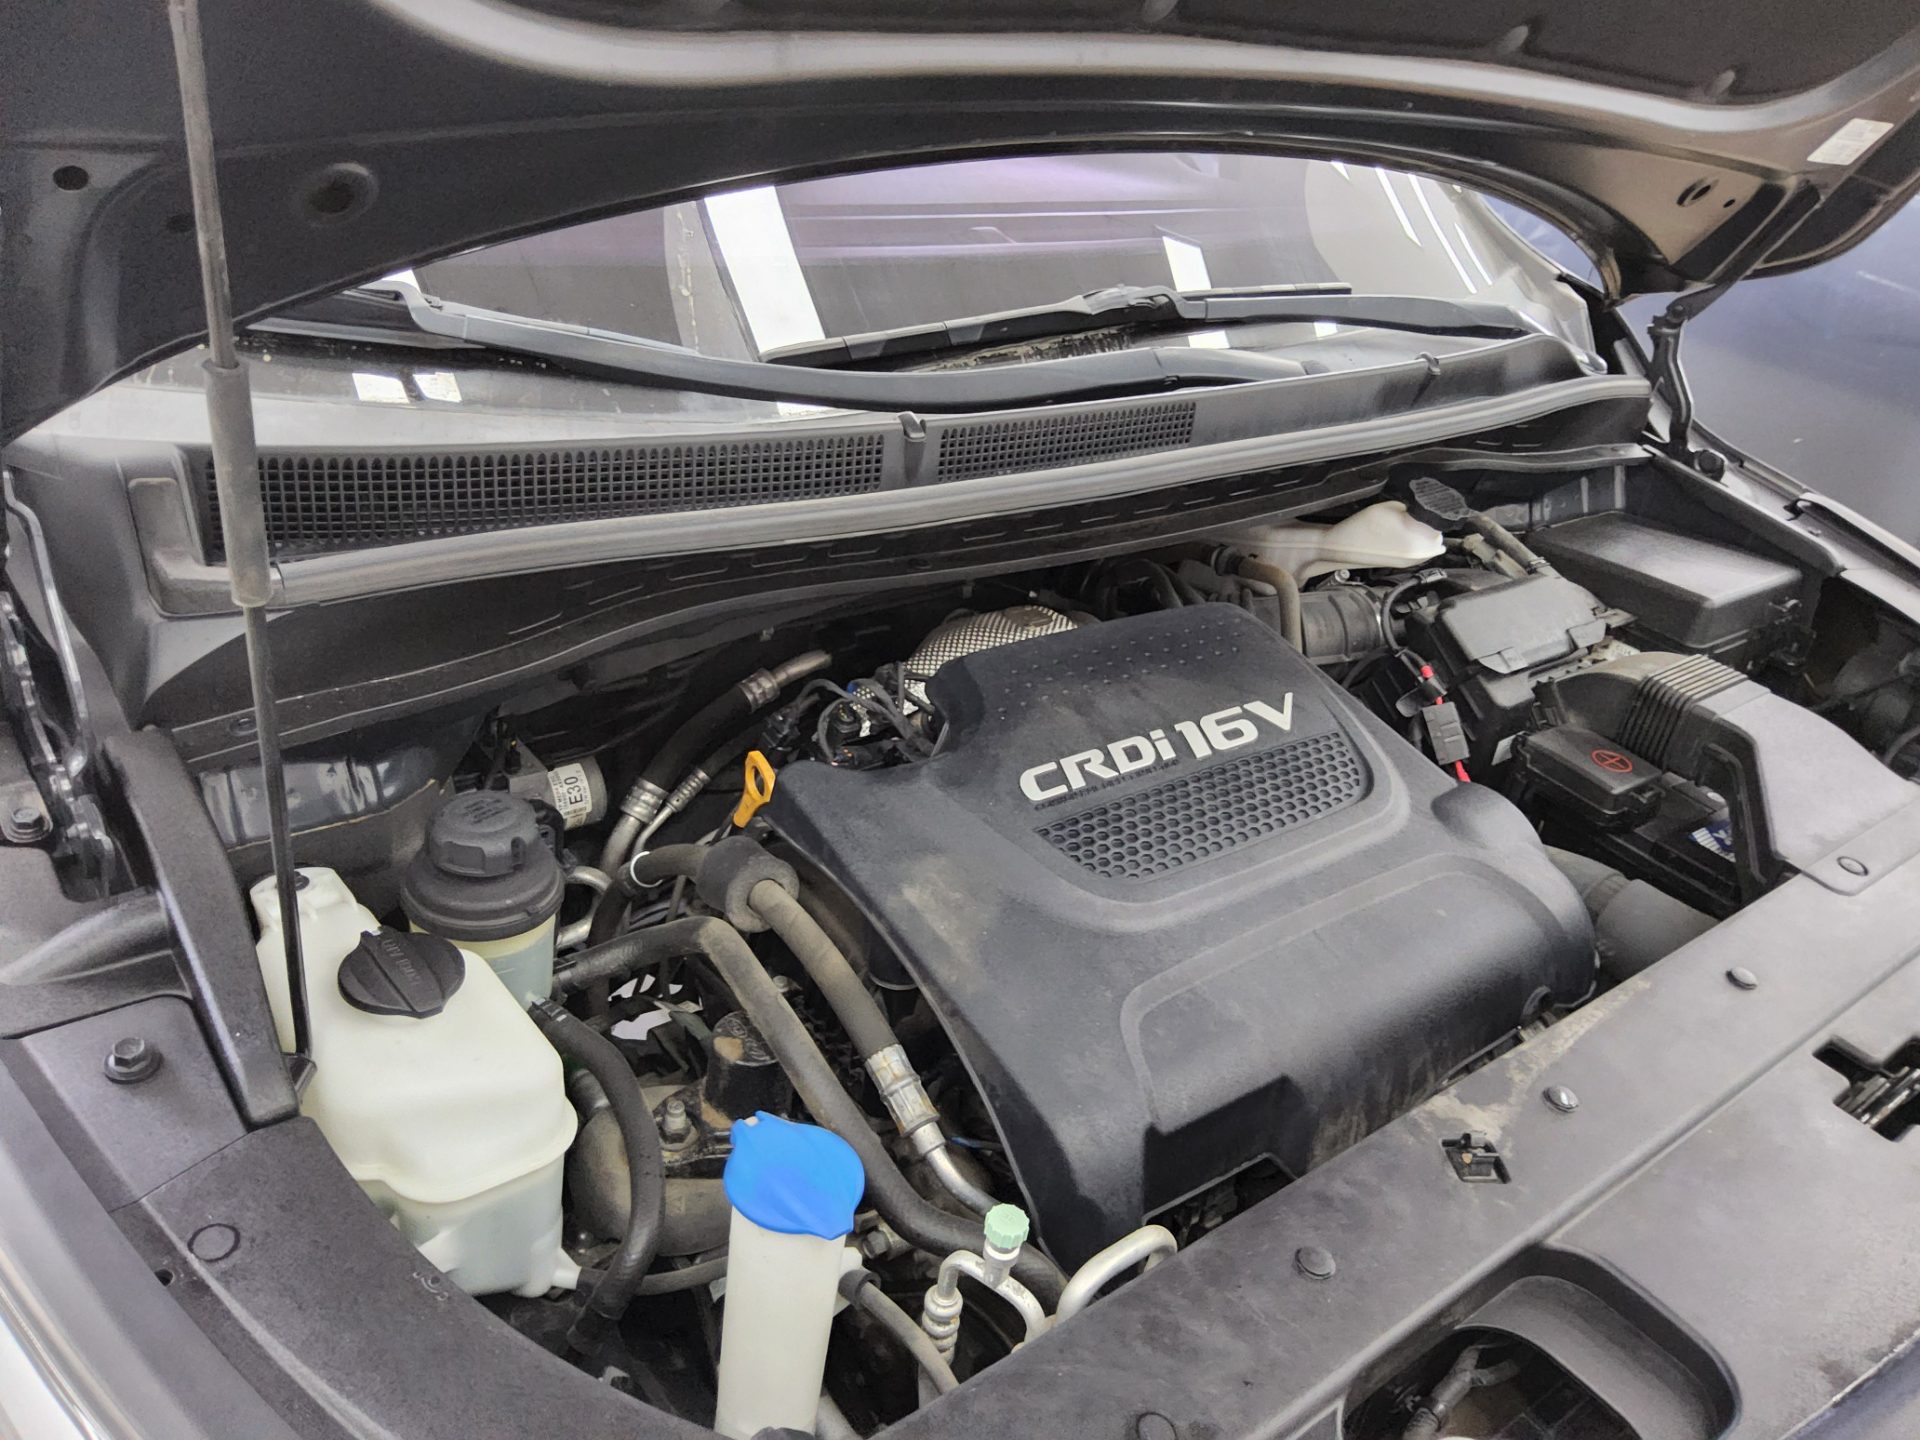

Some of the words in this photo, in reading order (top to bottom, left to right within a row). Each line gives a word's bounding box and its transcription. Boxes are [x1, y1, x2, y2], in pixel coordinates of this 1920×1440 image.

[1019, 728, 1177, 802] CRDi
[1174, 691, 1294, 760] 16V
[563, 776, 583, 805] E30
